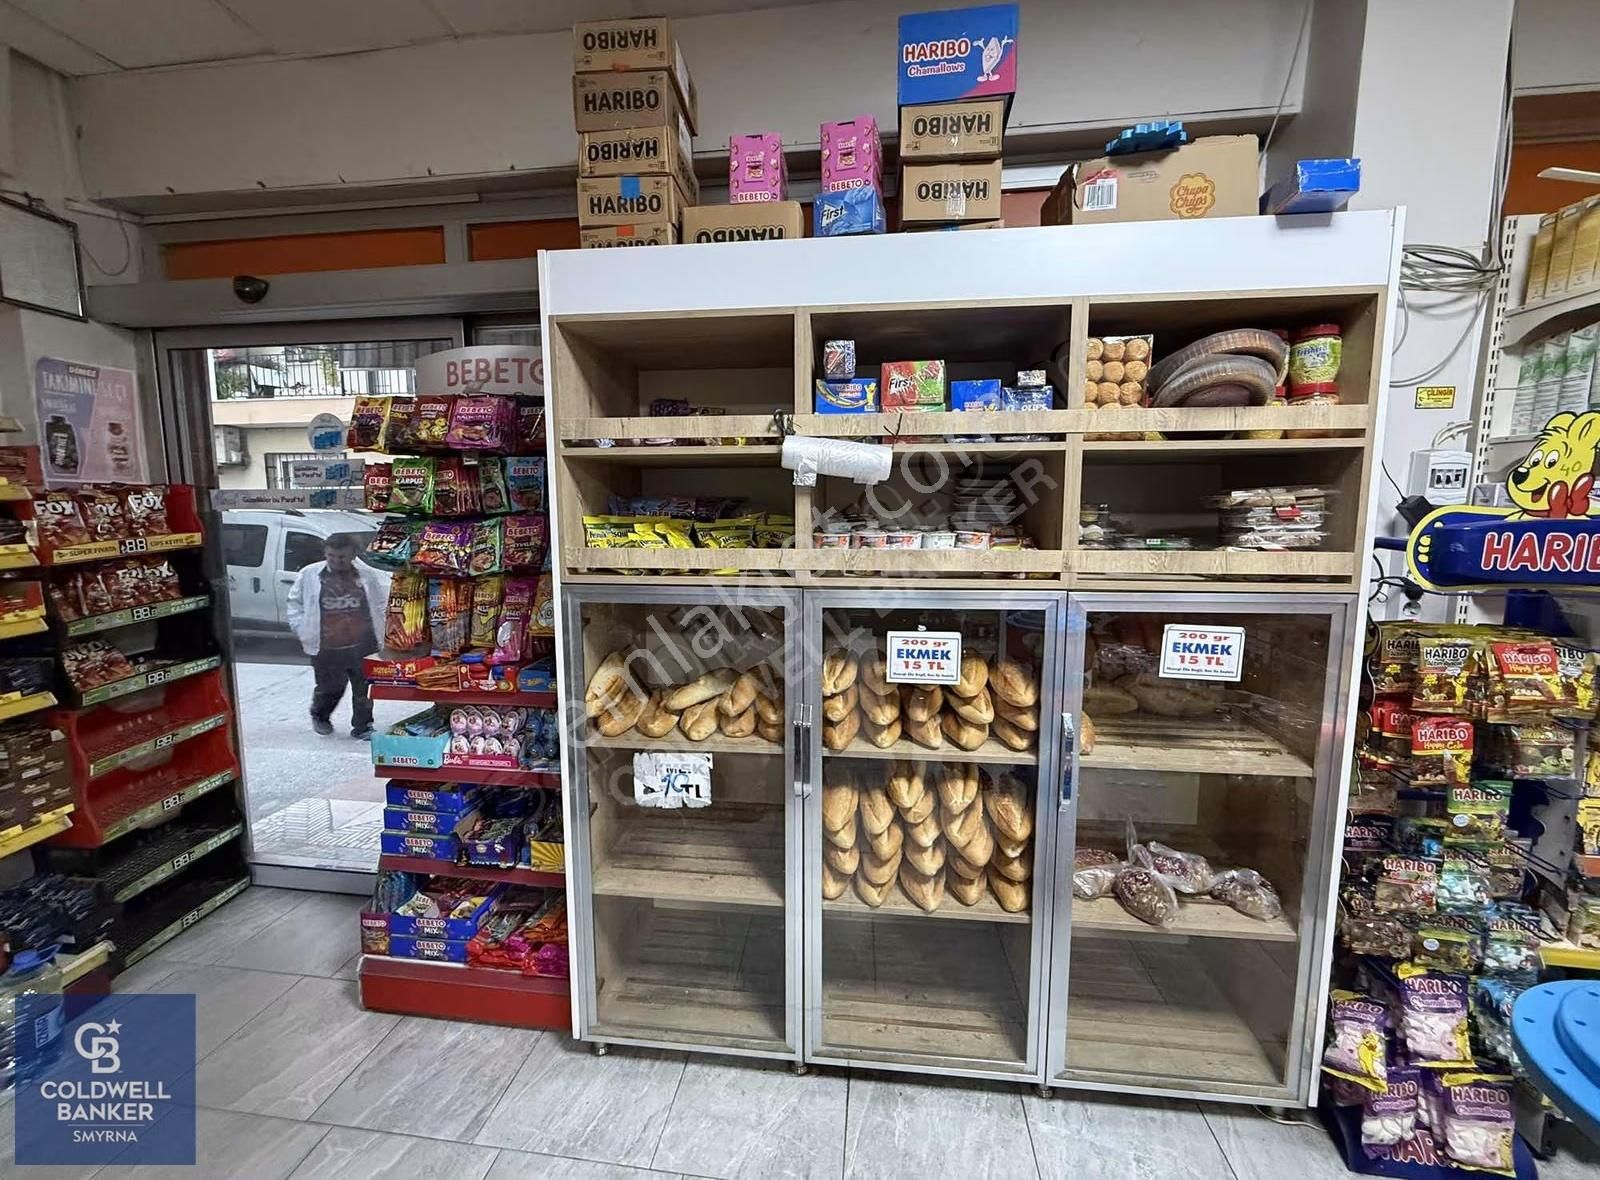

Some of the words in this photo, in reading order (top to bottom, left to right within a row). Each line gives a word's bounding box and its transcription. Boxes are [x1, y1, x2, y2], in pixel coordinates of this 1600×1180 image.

[583, 28, 657, 51] HARIBO
[903, 38, 971, 63] HARIBO
[908, 62, 965, 77] Chamallows
[584, 89, 660, 112] HARIBO
[913, 113, 992, 137] HARIBO
[586, 138, 658, 162] HARIBO
[830, 180, 862, 191] BEBETO
[917, 181, 989, 200] HARIBO
[1175, 184, 1210, 200] Chupa
[738, 192, 770, 202] BEBETO
[589, 194, 662, 215] HARIBO
[1175, 195, 1208, 213] Chups
[821, 205, 845, 222] First
[512, 466, 540, 475] BEBETO
[1178, 632, 1208, 640] 200
[896, 648, 952, 661] EKMEK
[1172, 642, 1233, 656] EKMEK
[1425, 647, 1469, 660] HARIBO
[903, 660, 922, 670] 15
[927, 661, 945, 670] TL
[1179, 655, 1199, 665] 15
[1205, 656, 1224, 666] TL
[1502, 652, 1552, 665] HARIBO
[1418, 729, 1469, 741] HARIBO
[392, 756, 418, 765] BEBETO
[408, 790, 434, 800] BEBETO
[1453, 788, 1504, 801] HARIBO
[408, 814, 436, 823] BEBETO
[405, 838, 434, 847] BEBETO
[1384, 858, 1436, 873] HARIBO
[416, 918, 446, 928] BEBETO
[416, 941, 446, 951] BEBETO
[1452, 1087, 1511, 1103] HARIBO
